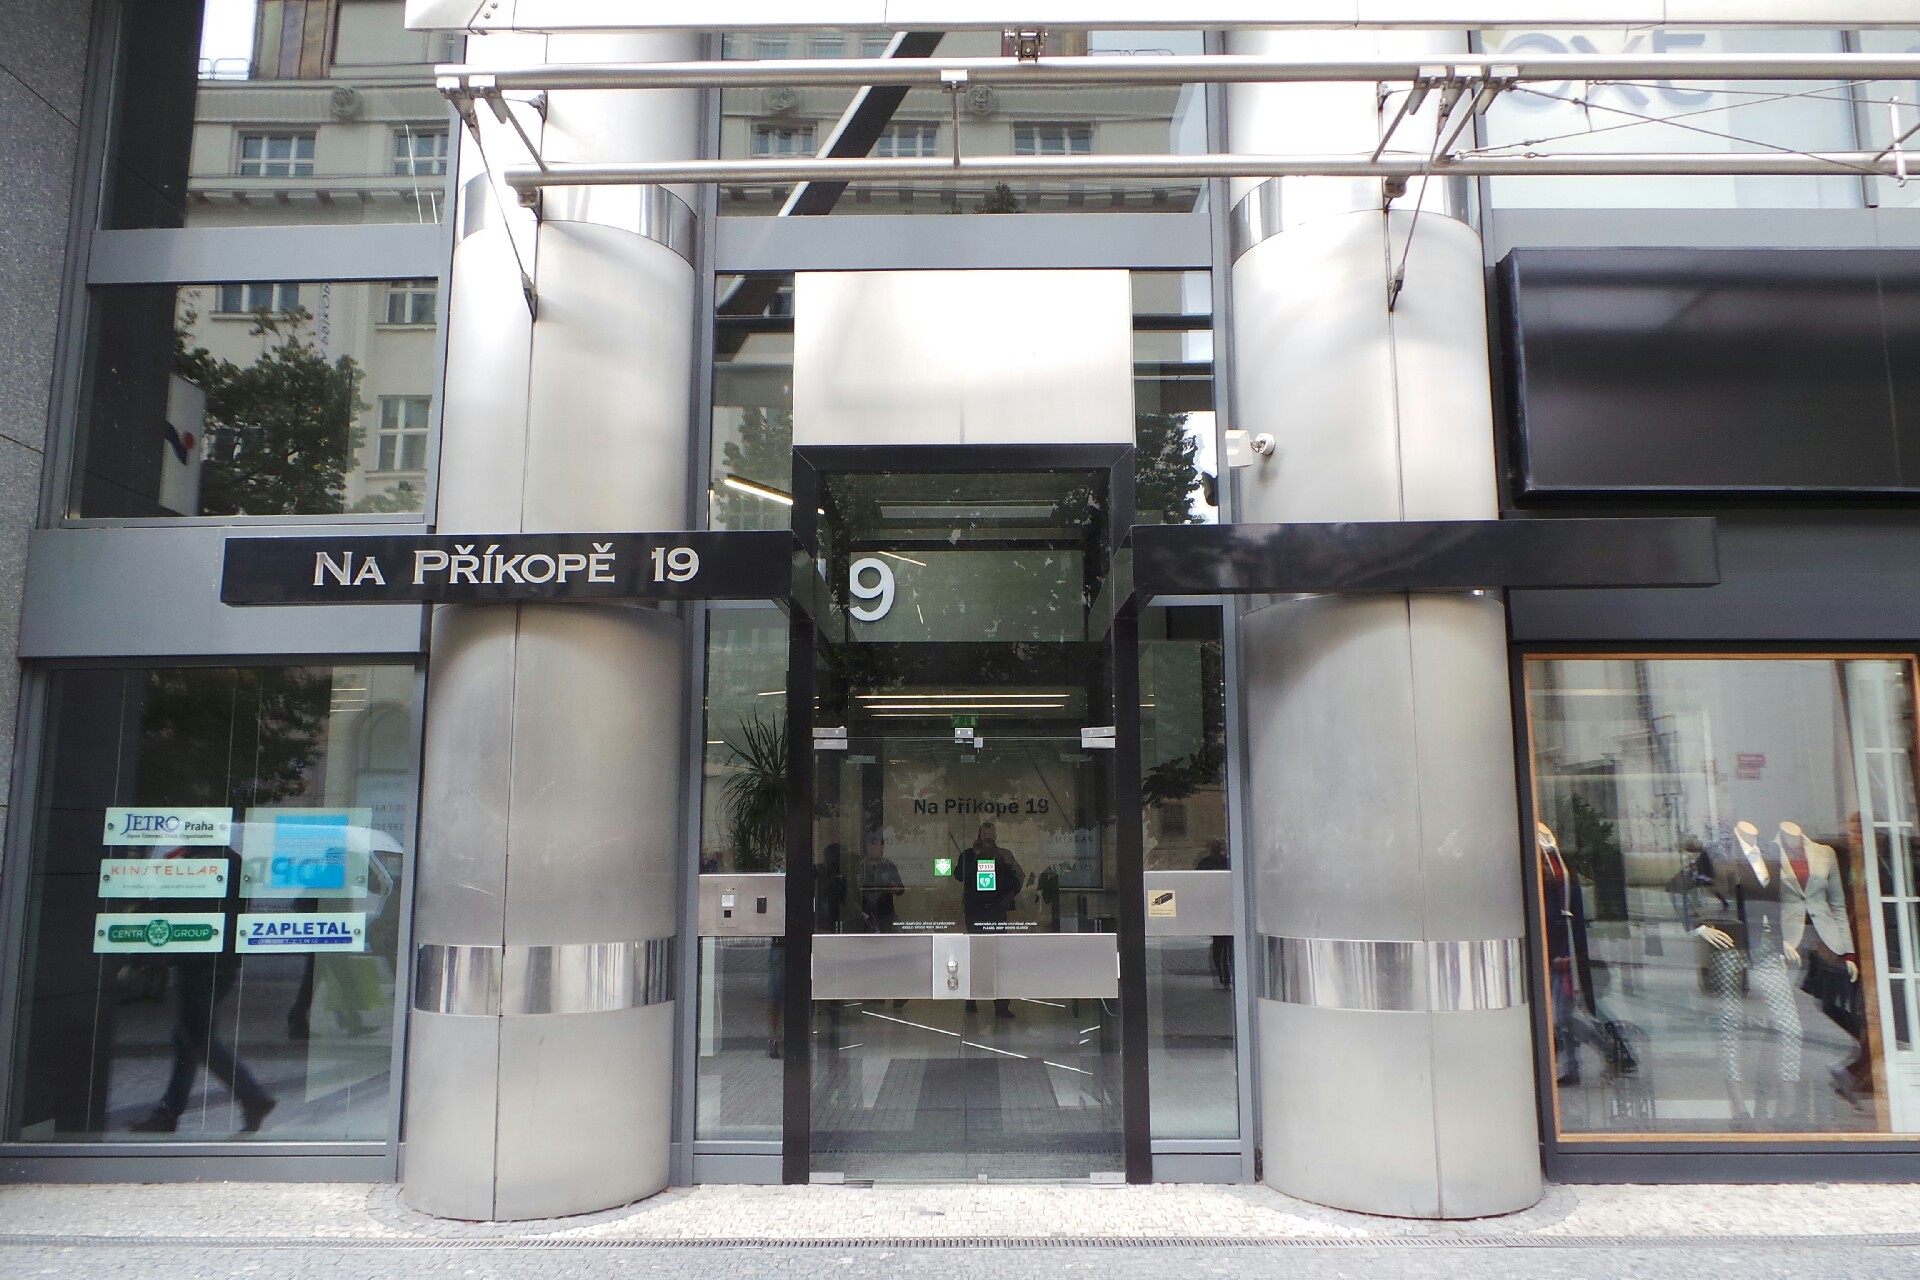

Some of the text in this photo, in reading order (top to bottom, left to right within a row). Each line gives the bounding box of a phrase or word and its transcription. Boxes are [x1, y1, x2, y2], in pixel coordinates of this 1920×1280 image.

[313, 542, 700, 586] NA PŘÍKOPĚ 19
[914, 798, 939, 815] Na
[1025, 798, 1050, 814] 19
[120, 813, 214, 833] JETRO Praha
[110, 865, 219, 876] KINSTELLAR
[173, 928, 210, 938] GROUP
[251, 921, 351, 936] ZAPLETAL
